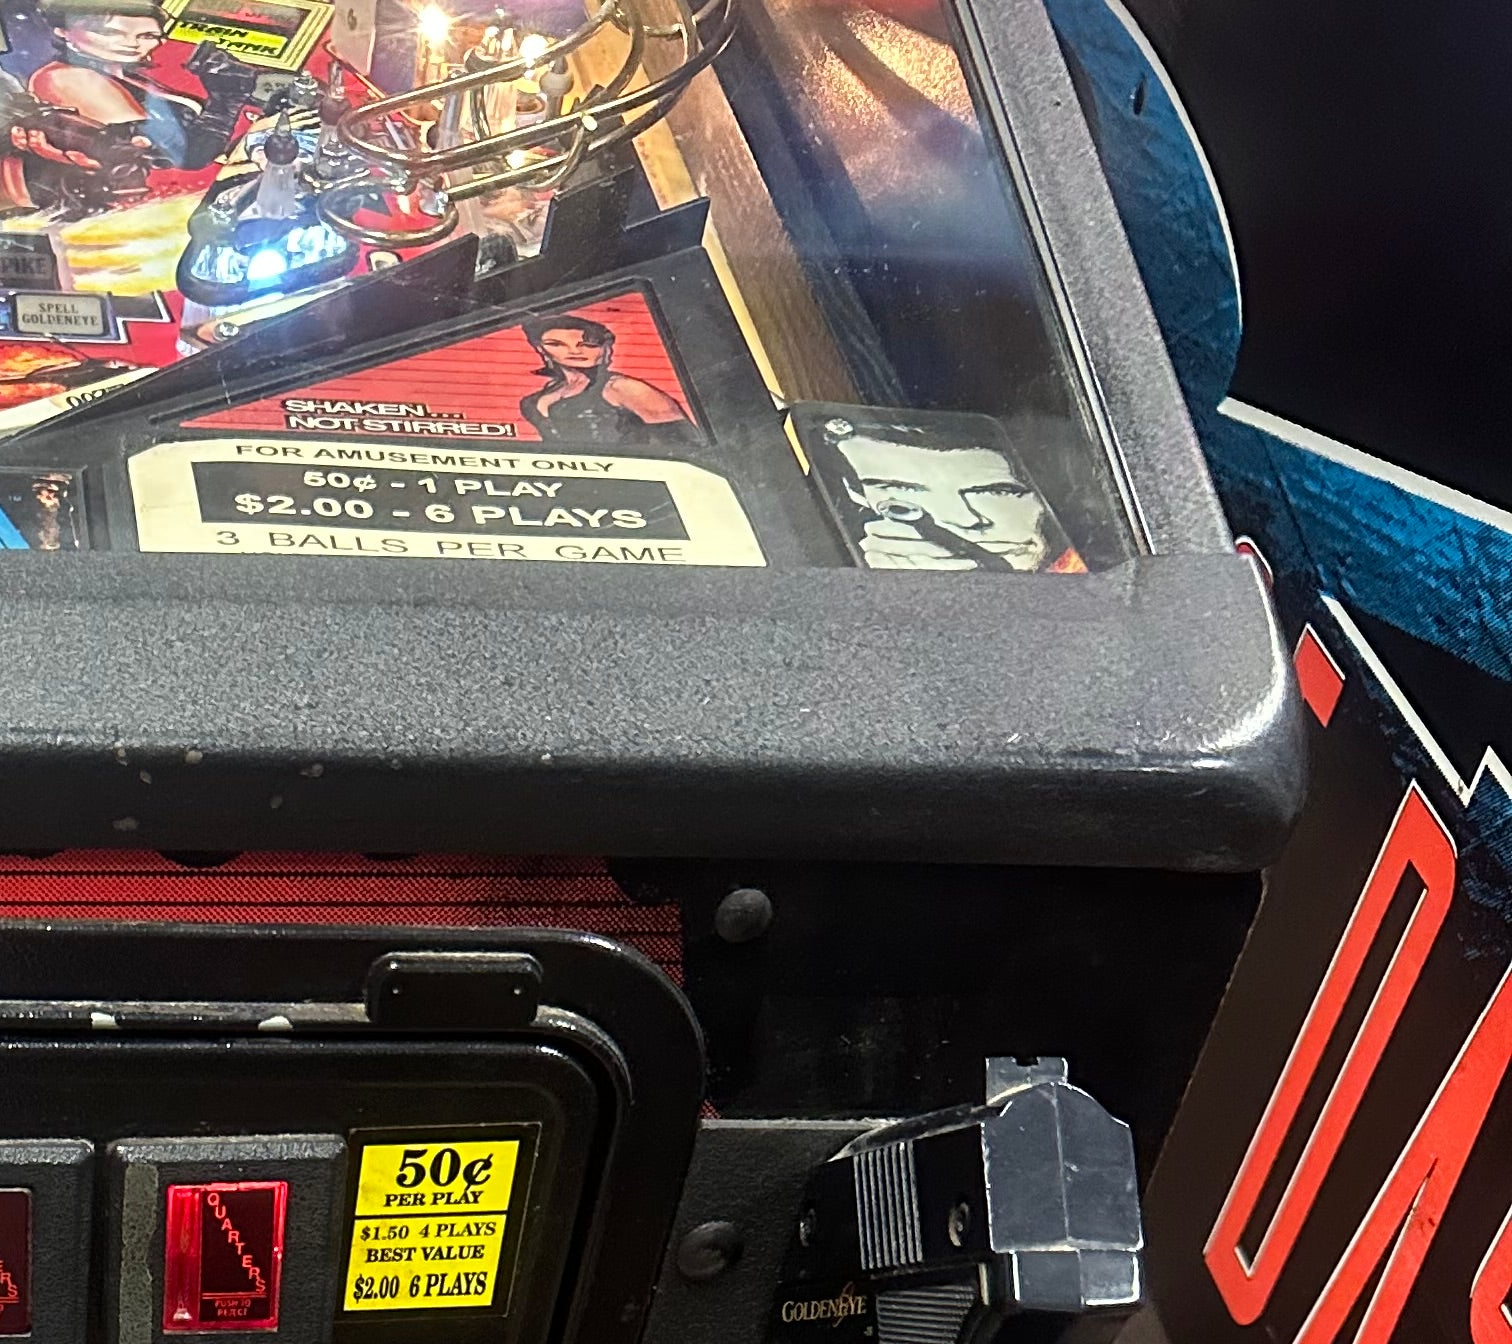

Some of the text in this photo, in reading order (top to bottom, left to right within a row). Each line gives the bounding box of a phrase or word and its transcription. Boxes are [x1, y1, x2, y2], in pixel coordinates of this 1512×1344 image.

[22, 313, 99, 327] GOLDENEYE
[38, 302, 79, 314] SPELL
[289, 415, 515, 437] NOT STIRRED!
[236, 445, 616, 474] FOR AMUSEMENT ONLY
[303, 470, 377, 493] 50¢
[418, 477, 437, 494] 1
[454, 478, 563, 500] PLAY
[234, 493, 374, 520] $2.00
[425, 504, 455, 524] 6
[472, 505, 649, 530] PLAYS
[216, 530, 687, 563] 3 BALLS PER GAME
[395, 1147, 494, 1191] 50¢
[383, 1190, 485, 1208] PER PLAY
[207, 1192, 267, 1293] QUARTERS
[359, 1221, 497, 1242] $1.50 4 PLAYS
[364, 1245, 486, 1263] BEST VALUE
[352, 1271, 489, 1304] $2.00 6 PLAYS
